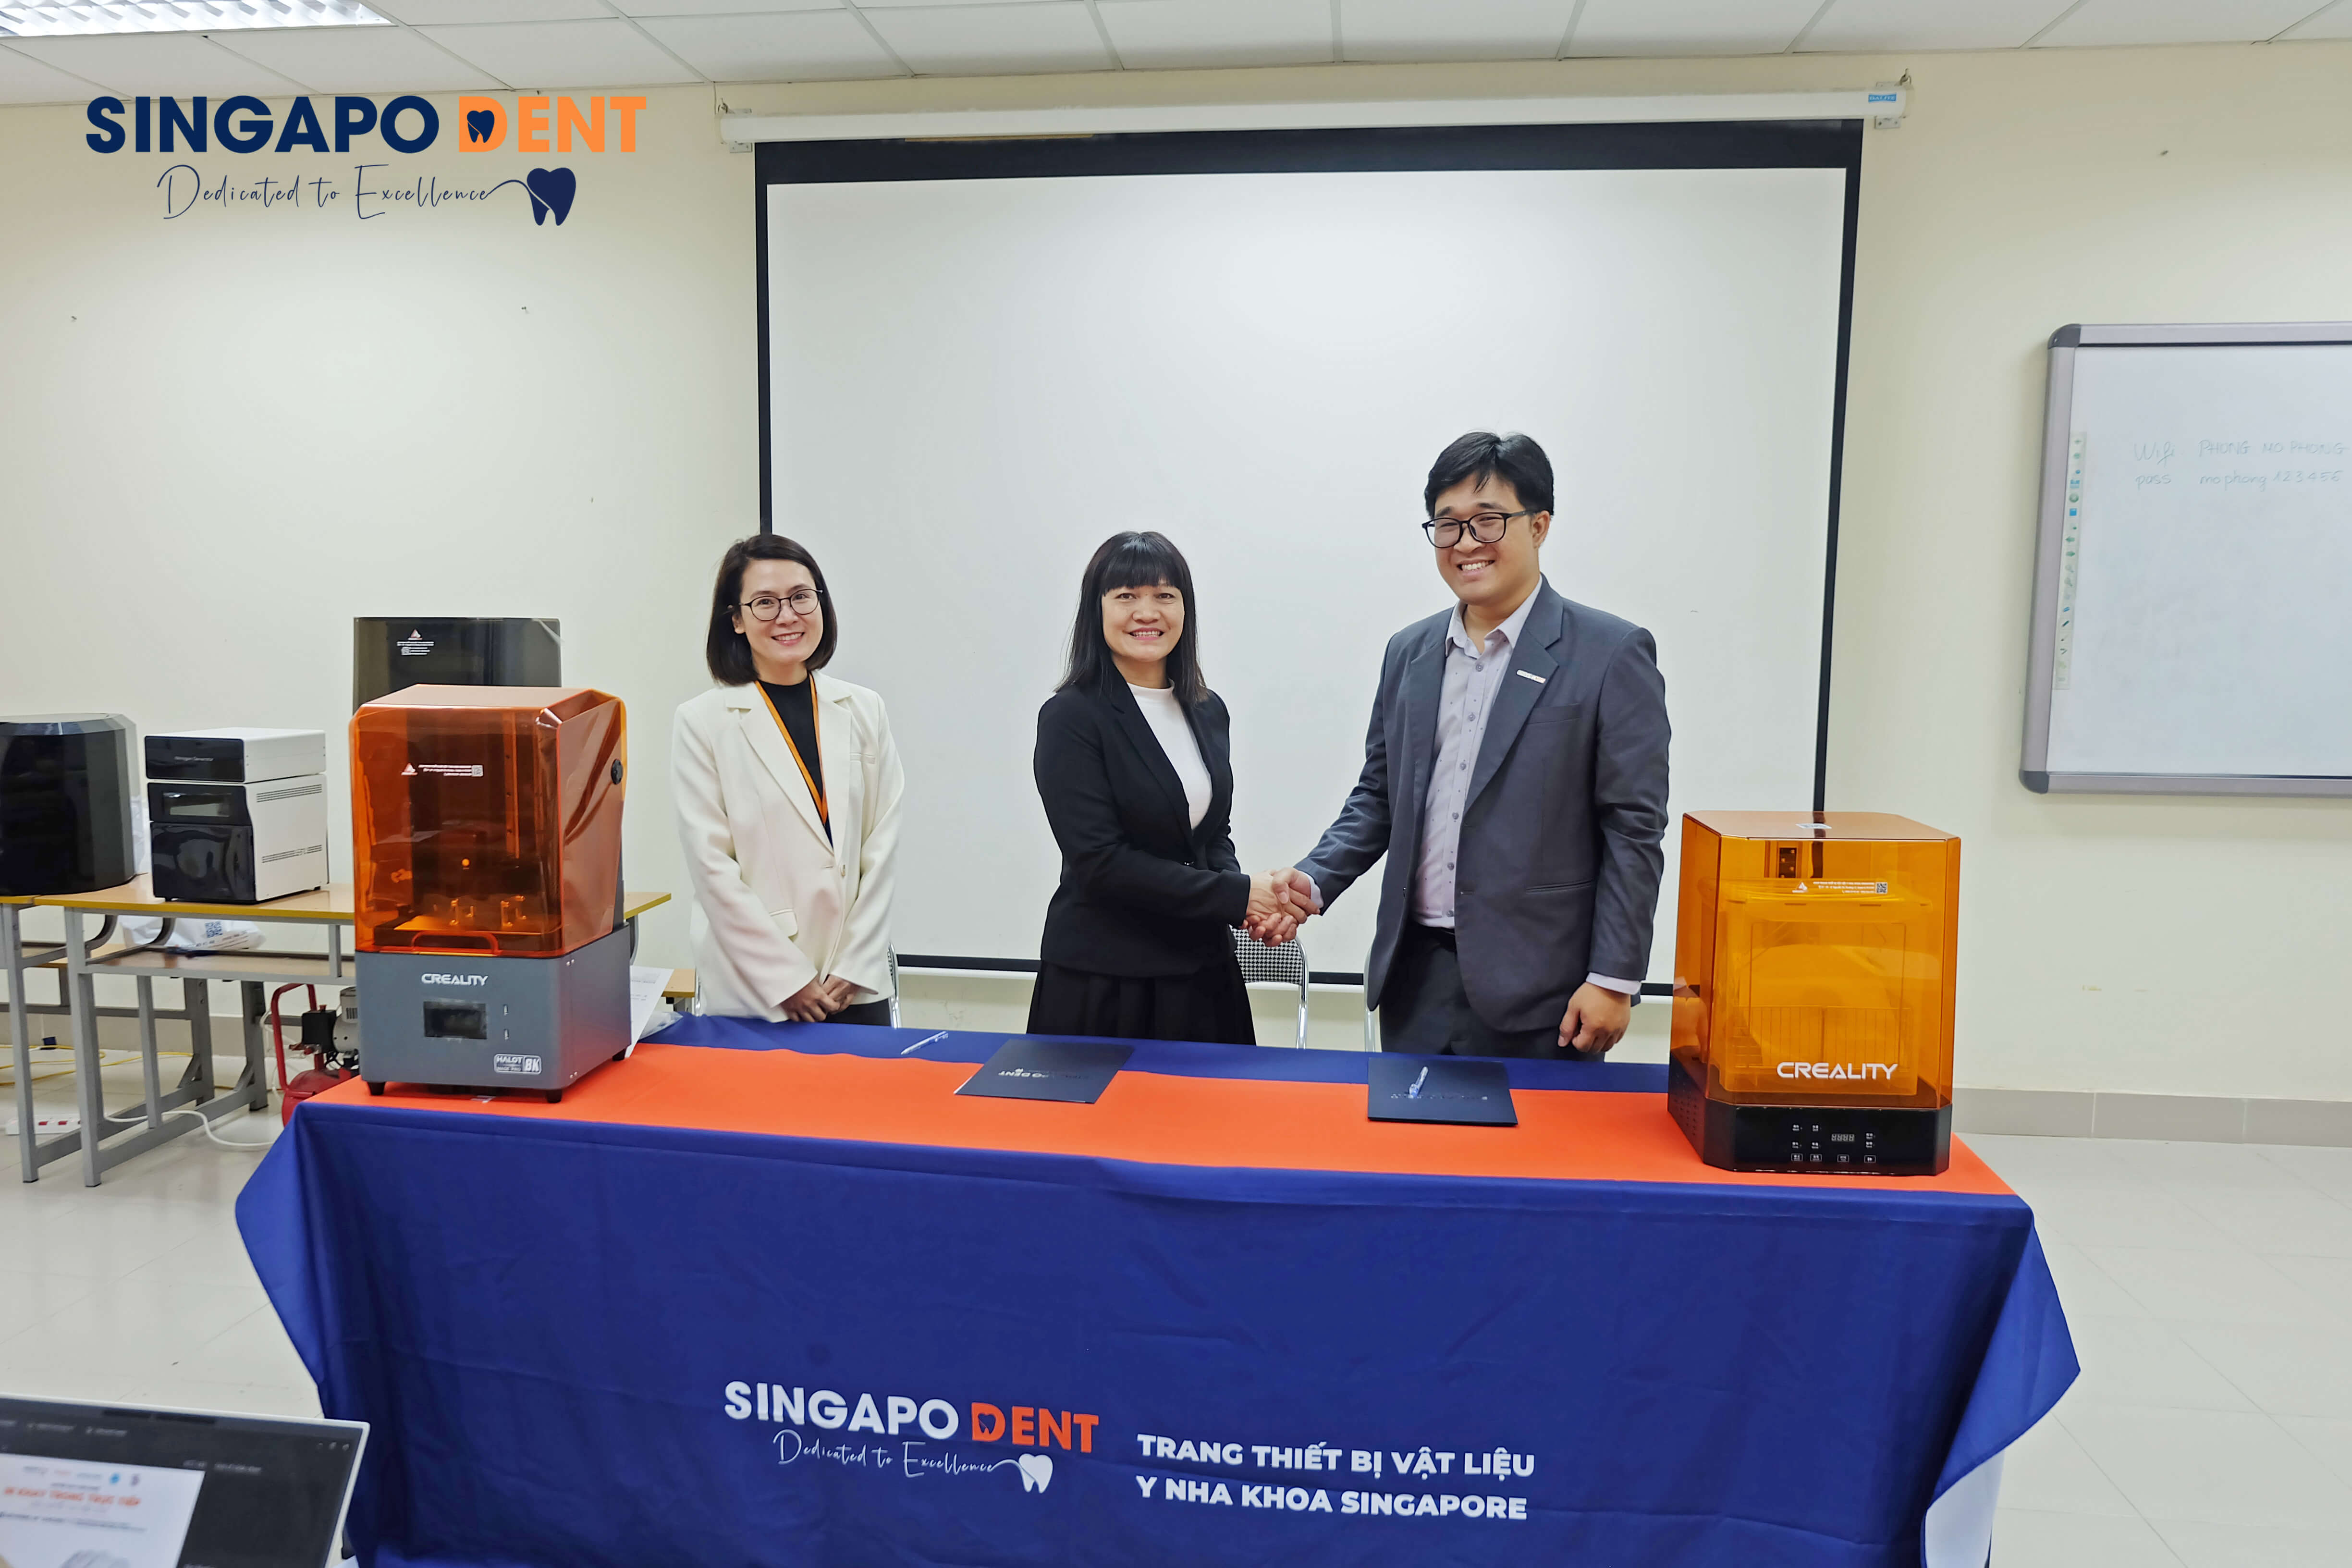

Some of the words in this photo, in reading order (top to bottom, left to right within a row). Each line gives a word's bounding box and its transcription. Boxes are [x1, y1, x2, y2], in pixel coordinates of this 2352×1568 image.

[2135, 474, 2172, 490] pass
[421, 973, 489, 986] CREALITY
[525, 1058, 539, 1072] 8K
[1776, 1062, 1898, 1080] CREALITY
[724, 1381, 959, 1440] SINGAPO
[971, 1402, 1100, 1453] DENT
[773, 1429, 867, 1466] Dedicated
[871, 1447, 893, 1468] to
[902, 1441, 994, 1478] Excellence
[1137, 1434, 1243, 1465] TRANG
[1251, 1442, 1342, 1470] THIẾT
[1351, 1450, 1382, 1479] BỊ
[1391, 1446, 1455, 1480] VẬT
[1464, 1447, 1534, 1481] LIỆU
[1136, 1475, 1157, 1498] Y
[1165, 1478, 1233, 1505] NHA
[1242, 1485, 1333, 1513] KHOA
[1341, 1491, 1527, 1519] SINGAPORE
